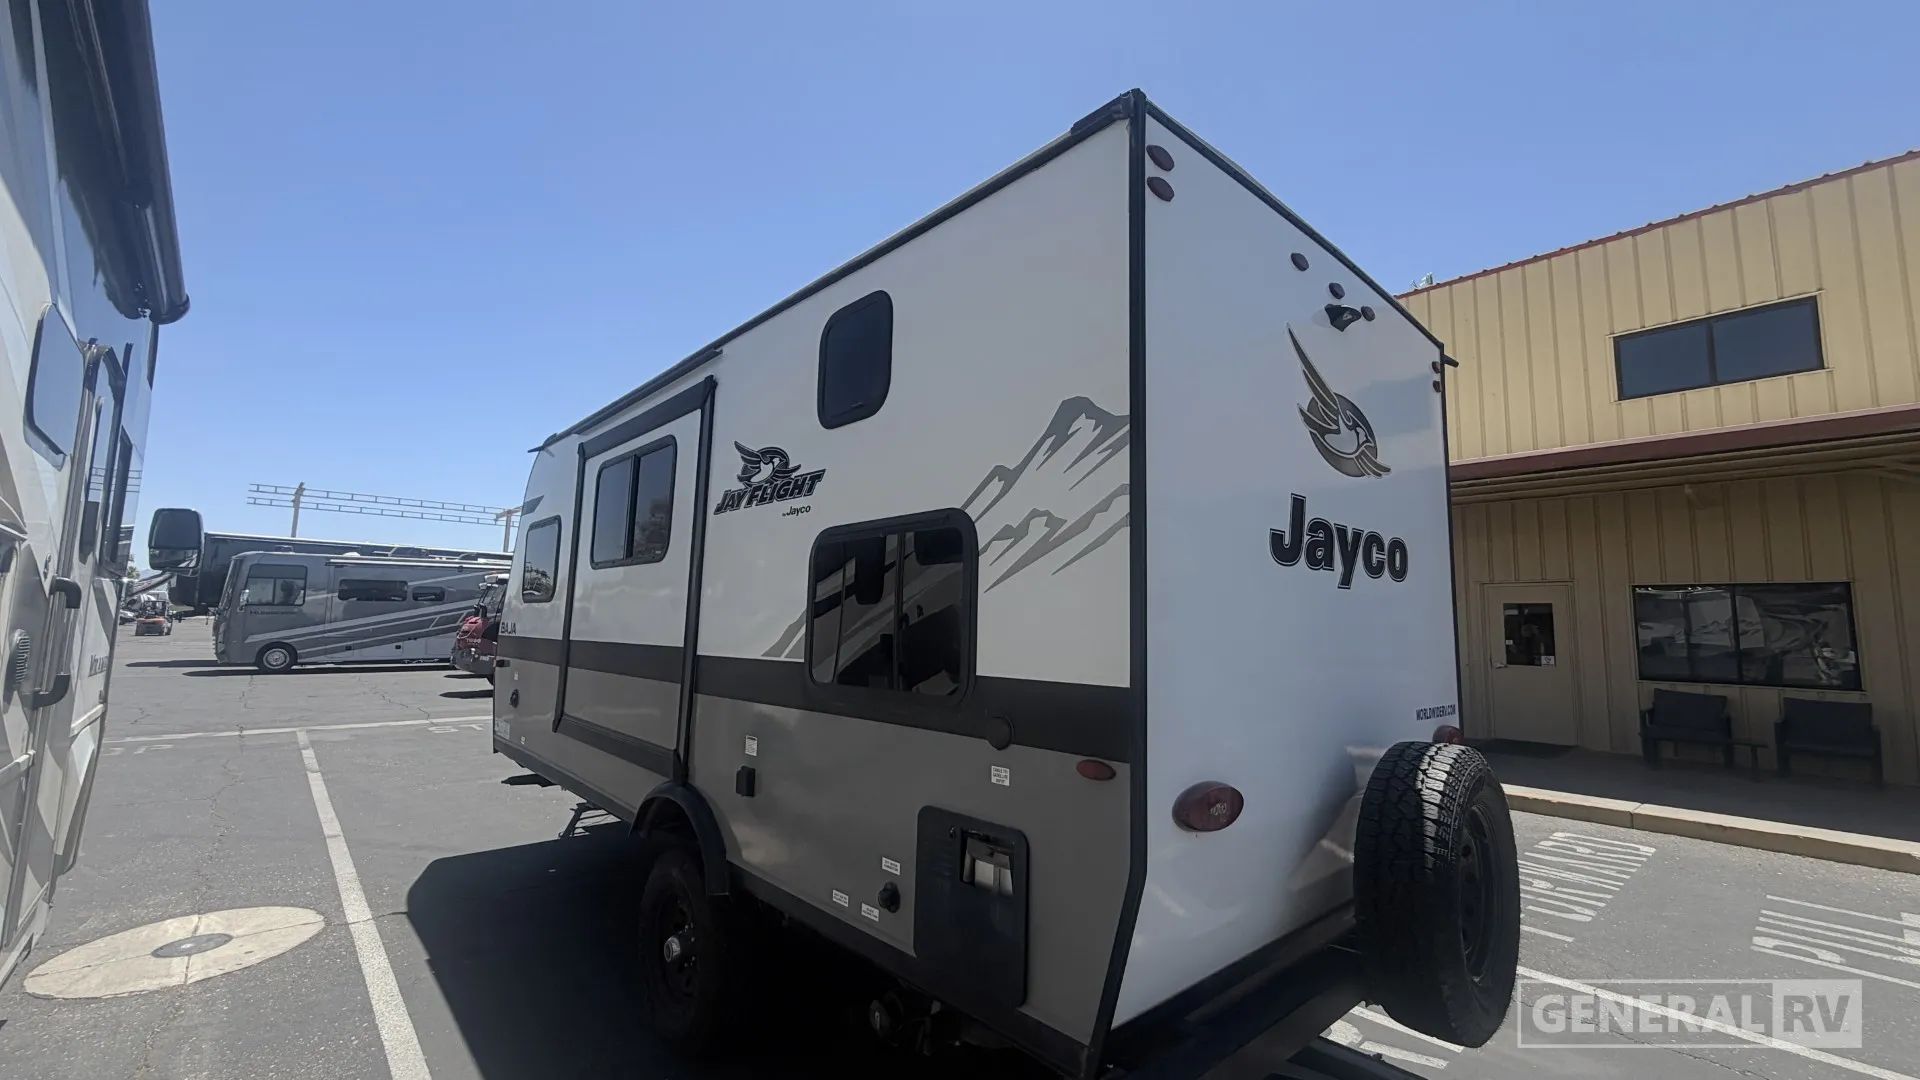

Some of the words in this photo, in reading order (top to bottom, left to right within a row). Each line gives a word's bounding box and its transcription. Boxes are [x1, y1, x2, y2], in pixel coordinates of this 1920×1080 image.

[787, 505, 812, 516] Jayco
[1269, 492, 1409, 589] Jayco
[500, 622, 517, 635] BAJA
